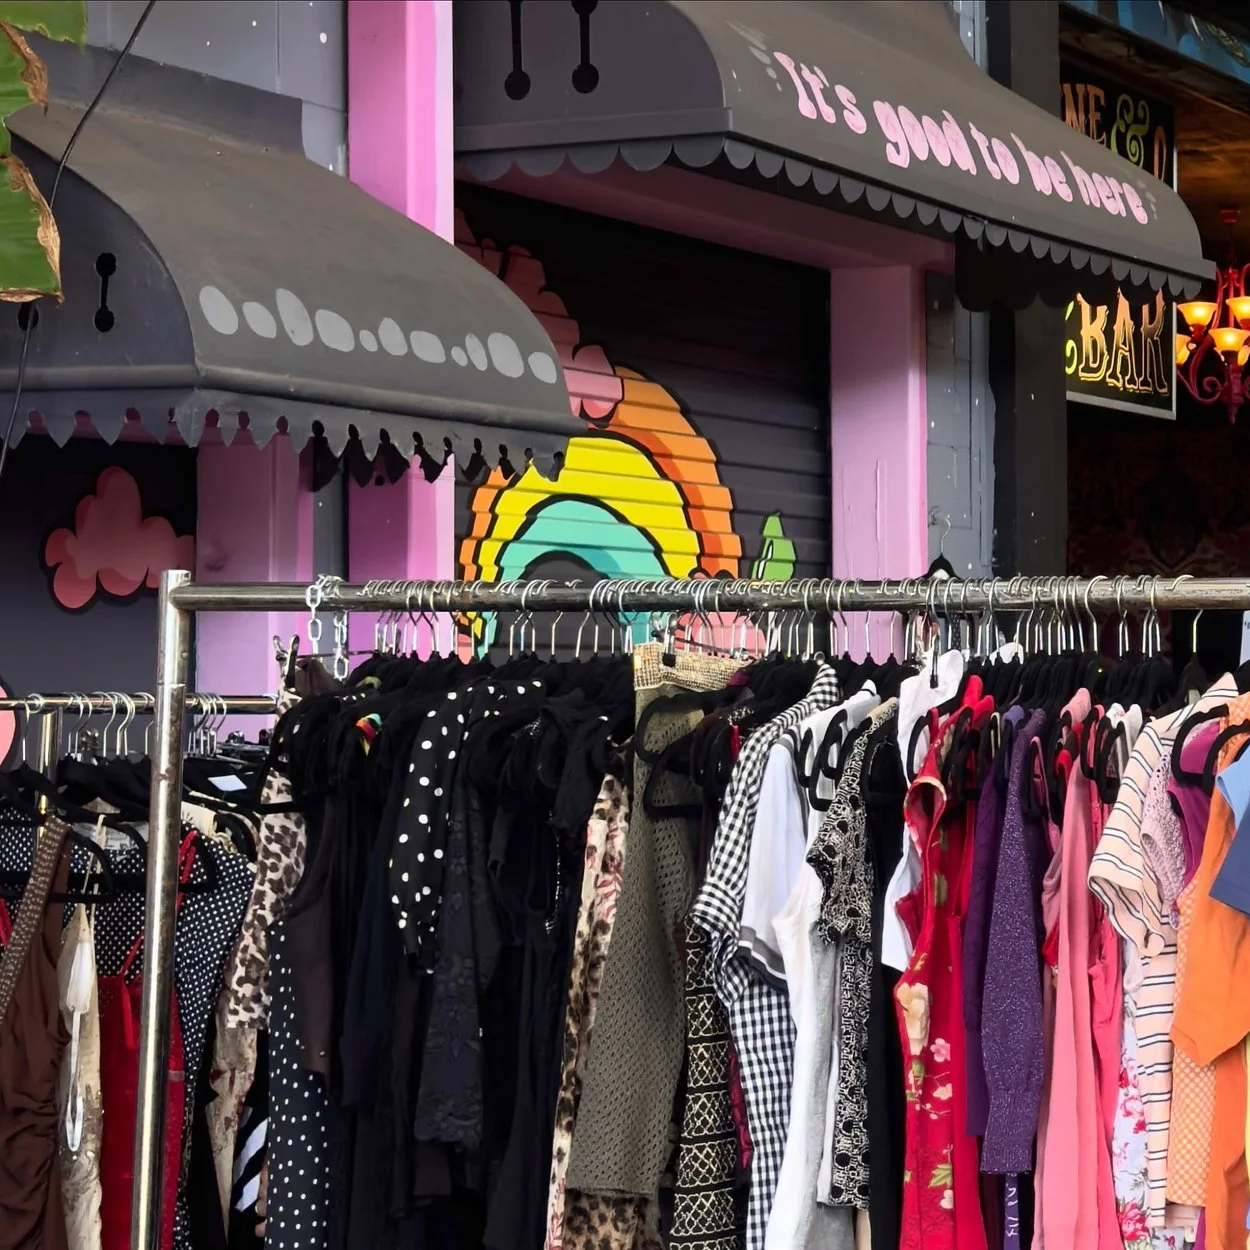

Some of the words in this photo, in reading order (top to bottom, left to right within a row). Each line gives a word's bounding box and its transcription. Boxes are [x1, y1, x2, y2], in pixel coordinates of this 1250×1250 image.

[773, 51, 867, 134] It's
[873, 99, 977, 176] good
[970, 122, 1020, 185] to
[1011, 133, 1073, 202] be
[1060, 151, 1149, 225] here
[1077, 287, 1169, 395] BAR
